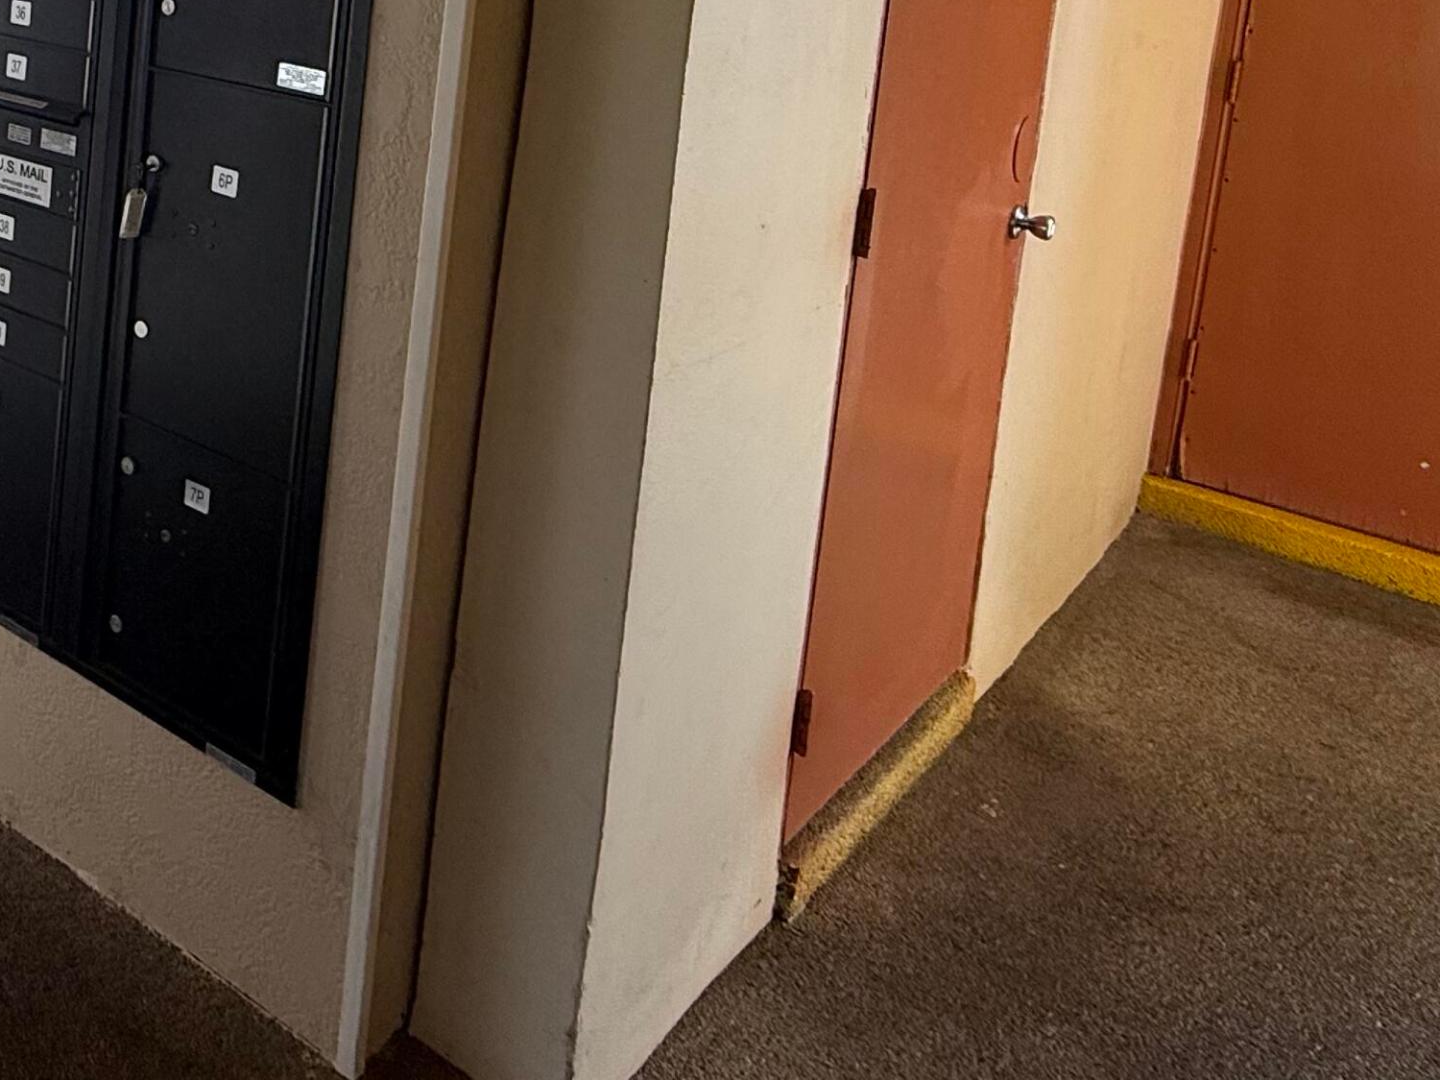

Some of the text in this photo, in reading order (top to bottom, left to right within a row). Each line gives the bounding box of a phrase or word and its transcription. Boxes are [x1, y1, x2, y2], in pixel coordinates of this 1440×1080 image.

[15, 6, 26, 20] 36
[10, 60, 23, 72] 37
[20, 163, 48, 184] MAIL
[218, 173, 234, 188] 6P
[189, 486, 205, 503] 7P
